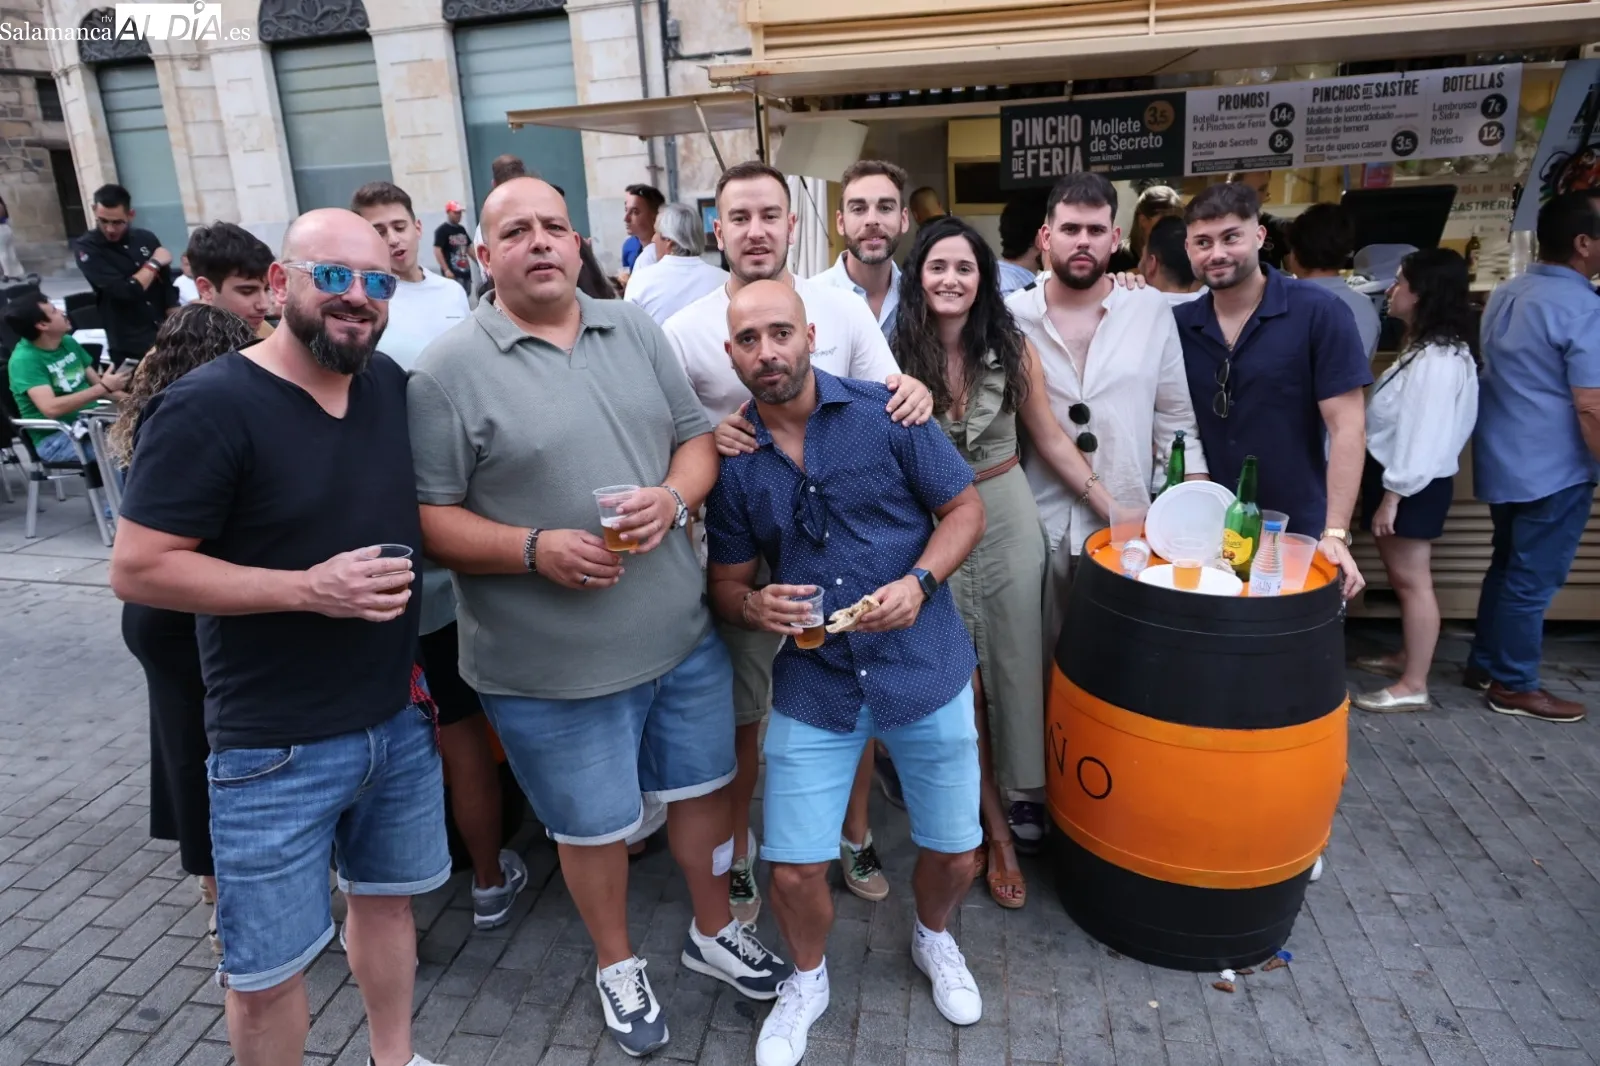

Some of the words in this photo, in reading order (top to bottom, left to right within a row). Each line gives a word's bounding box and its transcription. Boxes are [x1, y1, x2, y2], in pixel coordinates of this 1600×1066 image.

[1442, 72, 1505, 93] BOTELLAS
[1312, 84, 1360, 102] PINCHOS
[1375, 79, 1419, 98] SASTRE
[1218, 92, 1269, 110] PROMOS!
[1432, 100, 1478, 112] Lambrusco
[1306, 106, 1333, 116] Mollete
[1334, 104, 1343, 114] de
[1344, 102, 1372, 113] secreto
[1432, 113, 1438, 121] o
[1439, 110, 1461, 121] Sidra
[1193, 113, 1219, 124] Botella
[1199, 122, 1206, 132] 4
[1206, 120, 1236, 132] Pinchos
[1237, 119, 1247, 129] de
[1248, 118, 1266, 128] Feria
[1306, 115, 1333, 126] Mollete
[1333, 114, 1343, 124] de
[1343, 113, 1362, 123] lomo
[1363, 111, 1395, 121] adobado
[1012, 114, 1082, 147] PINCHO
[1090, 117, 1141, 137] Mollete
[1305, 125, 1332, 136] Mollete
[1333, 124, 1342, 134] de
[1343, 123, 1370, 133] ternera
[1431, 126, 1454, 136] Novio
[1090, 138, 1107, 153] de
[1110, 133, 1163, 150] Secreto
[1192, 140, 1217, 150] Ración
[1218, 138, 1229, 148] de
[1230, 137, 1258, 147] Secreto
[1305, 143, 1324, 153] Tarta
[1325, 142, 1335, 152] de
[1336, 141, 1360, 152] queso
[1361, 139, 1388, 150] casera
[1430, 134, 1464, 145] Perfecto
[1026, 146, 1083, 178] FERIA
[1101, 152, 1123, 161] kimchi
[1452, 200, 1512, 211] SASTRERI
